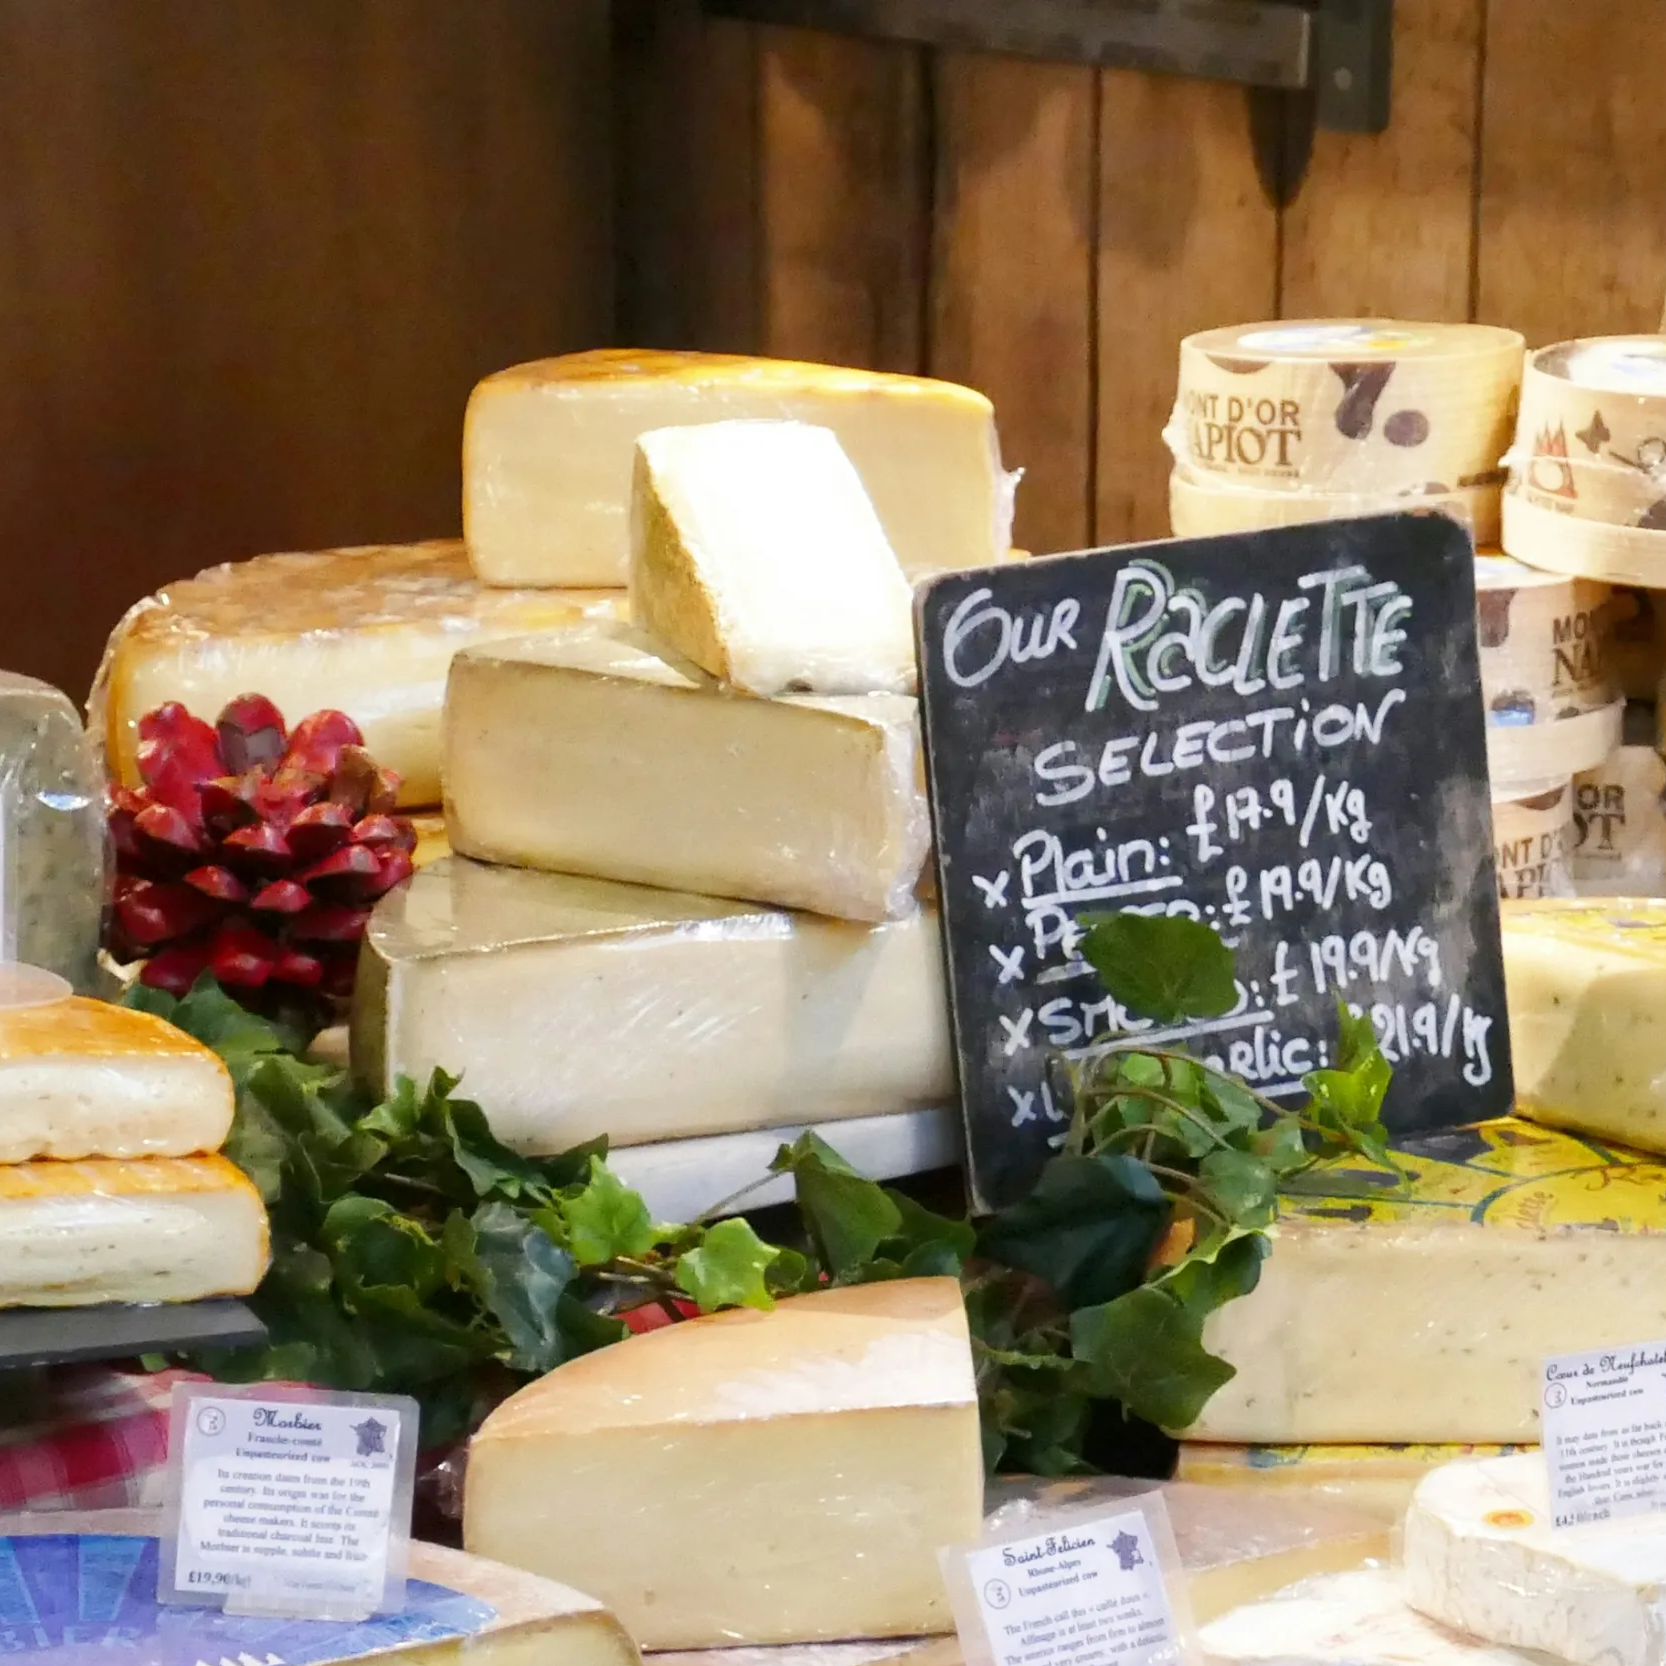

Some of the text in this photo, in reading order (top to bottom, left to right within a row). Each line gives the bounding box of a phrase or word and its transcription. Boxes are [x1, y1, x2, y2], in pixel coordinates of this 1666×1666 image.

[1228, 396, 1300, 425] D'OR
[1193, 422, 1302, 466] APIOT
[253, 1407, 322, 1431] Morbier
